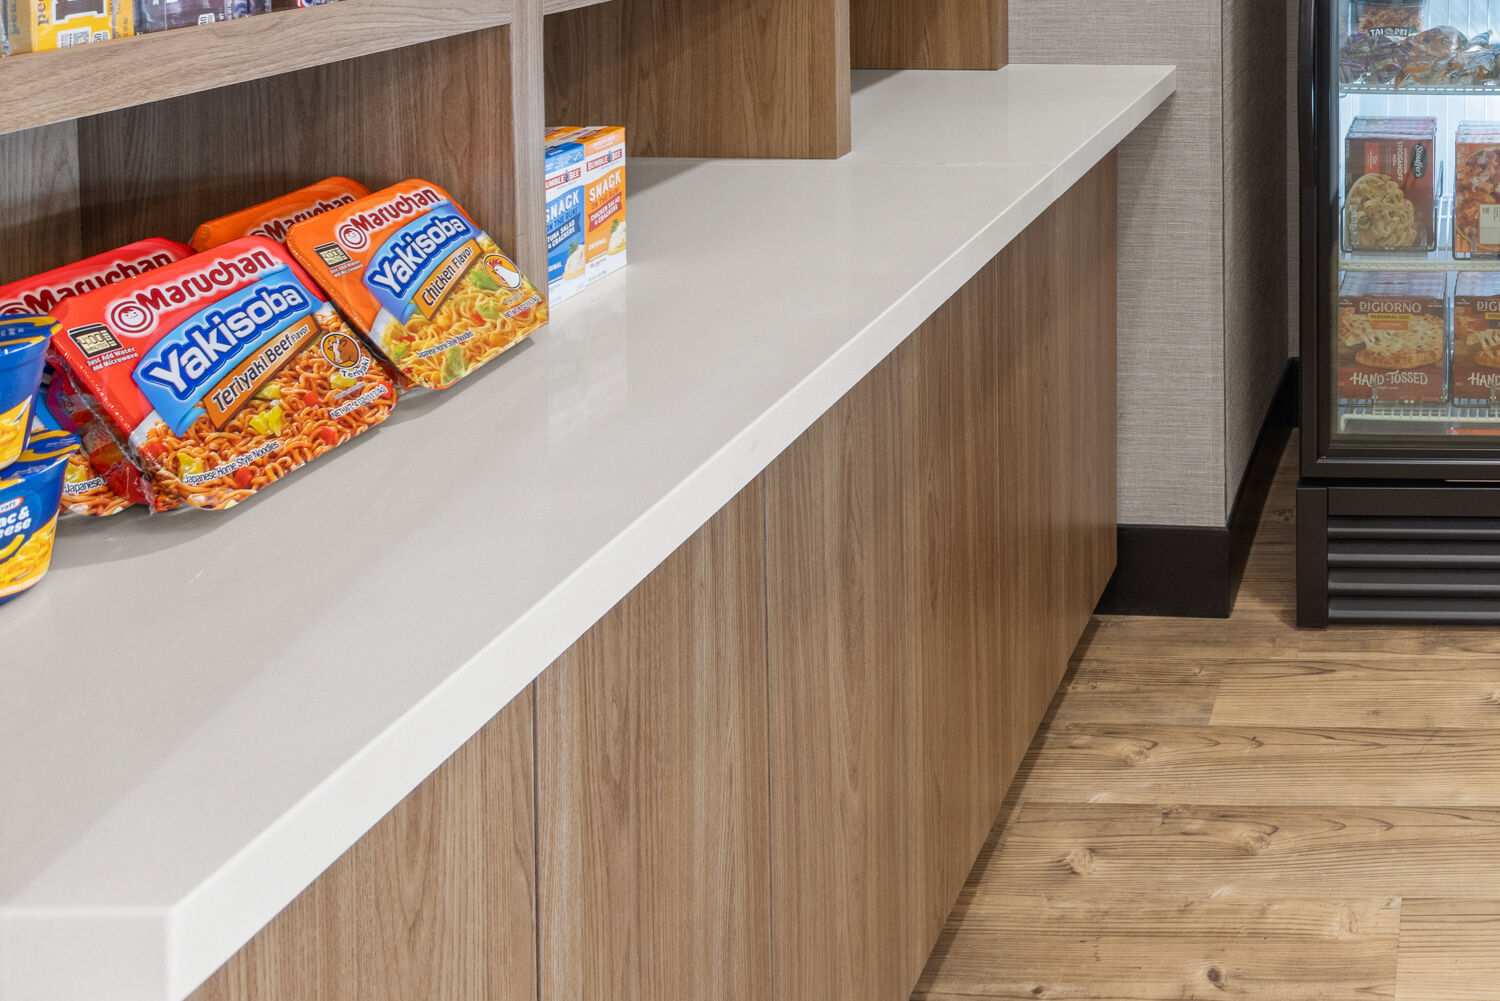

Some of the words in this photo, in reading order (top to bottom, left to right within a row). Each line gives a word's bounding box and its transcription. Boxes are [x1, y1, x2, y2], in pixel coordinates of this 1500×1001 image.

[1370, 27, 1384, 36] TAI
[1394, 28, 1408, 36] PEI
[611, 148, 623, 162] BEE
[589, 169, 621, 202] SNACK
[352, 188, 441, 232] Maruchan
[608, 196, 621, 211] SALAD
[554, 215, 565, 228] THE
[560, 219, 576, 235] SALAD
[552, 226, 576, 248] CRACKERS
[374, 215, 466, 294] Yakisoba
[135, 250, 276, 312] Maruchan
[423, 266, 454, 307] Chicken
[452, 245, 474, 275] Flavor
[149, 287, 305, 394] Yakisoba
[87, 357, 100, 367] Just
[101, 352, 114, 362] Add
[114, 347, 135, 358] Water
[92, 362, 103, 371] and
[104, 352, 139, 368] Microwave
[212, 358, 268, 412] Teriyaki
[266, 335, 294, 366] Beef
[292, 324, 310, 345] Flavor
[341, 356, 370, 379] Teriyaki
[1350, 369, 1428, 387] HAND-TOSSED
[184, 467, 217, 484] Japanese
[216, 464, 237, 479] Home
[236, 455, 253, 470] Style
[252, 441, 280, 461] Noodles
[65, 478, 103, 494] Japanese
